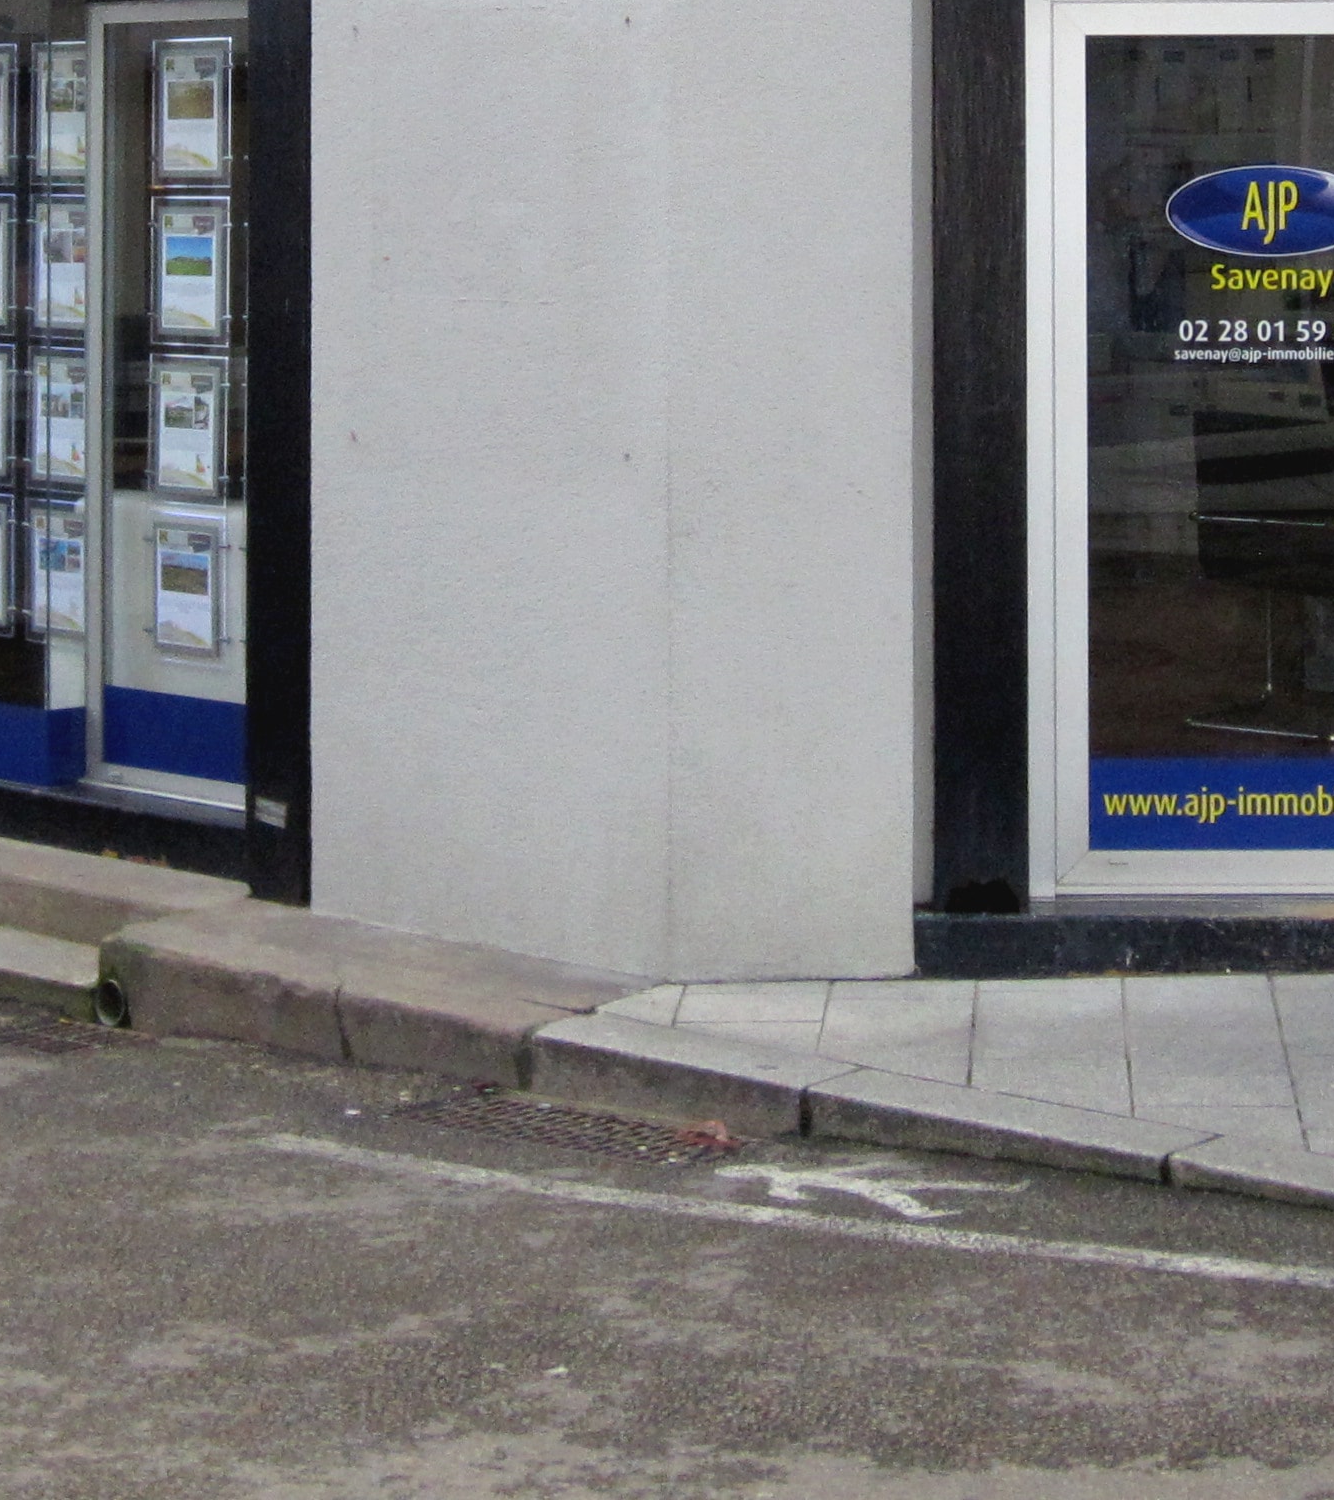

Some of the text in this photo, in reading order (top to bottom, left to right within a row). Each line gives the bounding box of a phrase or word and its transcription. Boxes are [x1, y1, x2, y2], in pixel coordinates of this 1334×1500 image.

[1240, 180, 1300, 245] AJP
[1210, 263, 1334, 298] Savenay
[1178, 319, 1209, 343] 02
[1217, 319, 1248, 343] 28
[1257, 319, 1285, 343] 01
[1295, 319, 1327, 343] 59
